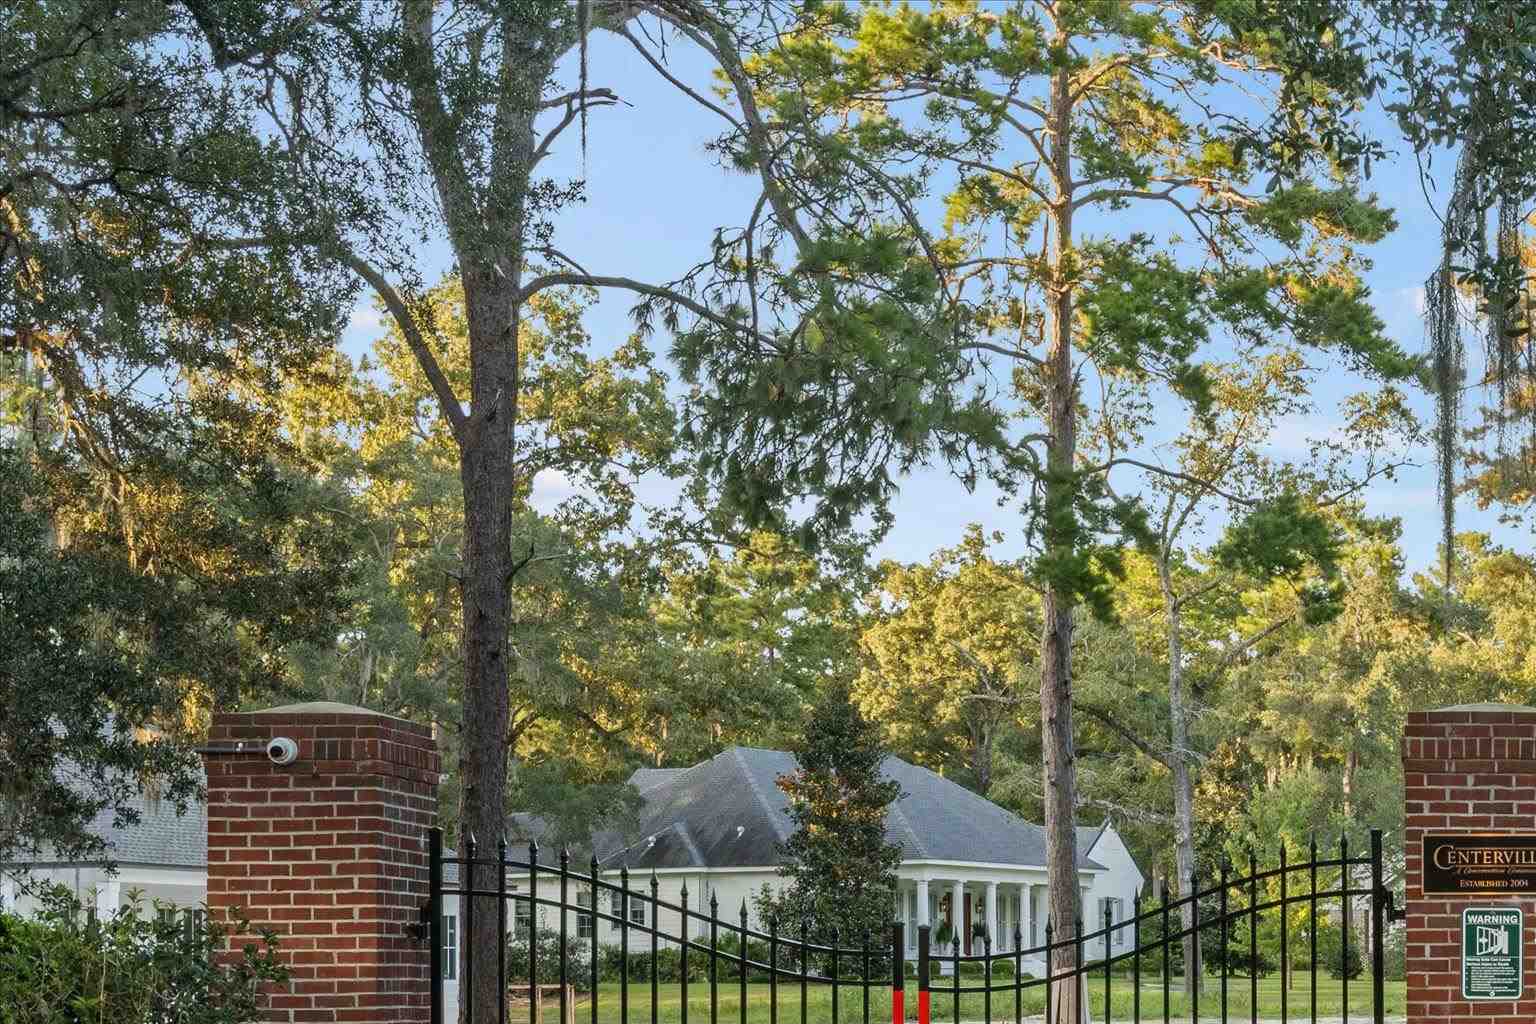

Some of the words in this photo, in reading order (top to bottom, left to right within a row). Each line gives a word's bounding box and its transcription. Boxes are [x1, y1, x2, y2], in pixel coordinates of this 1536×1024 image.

[1459, 879, 1508, 888] ESTABLISHED
[1510, 879, 1529, 888] 2004
[1467, 914, 1518, 925] WARNING
